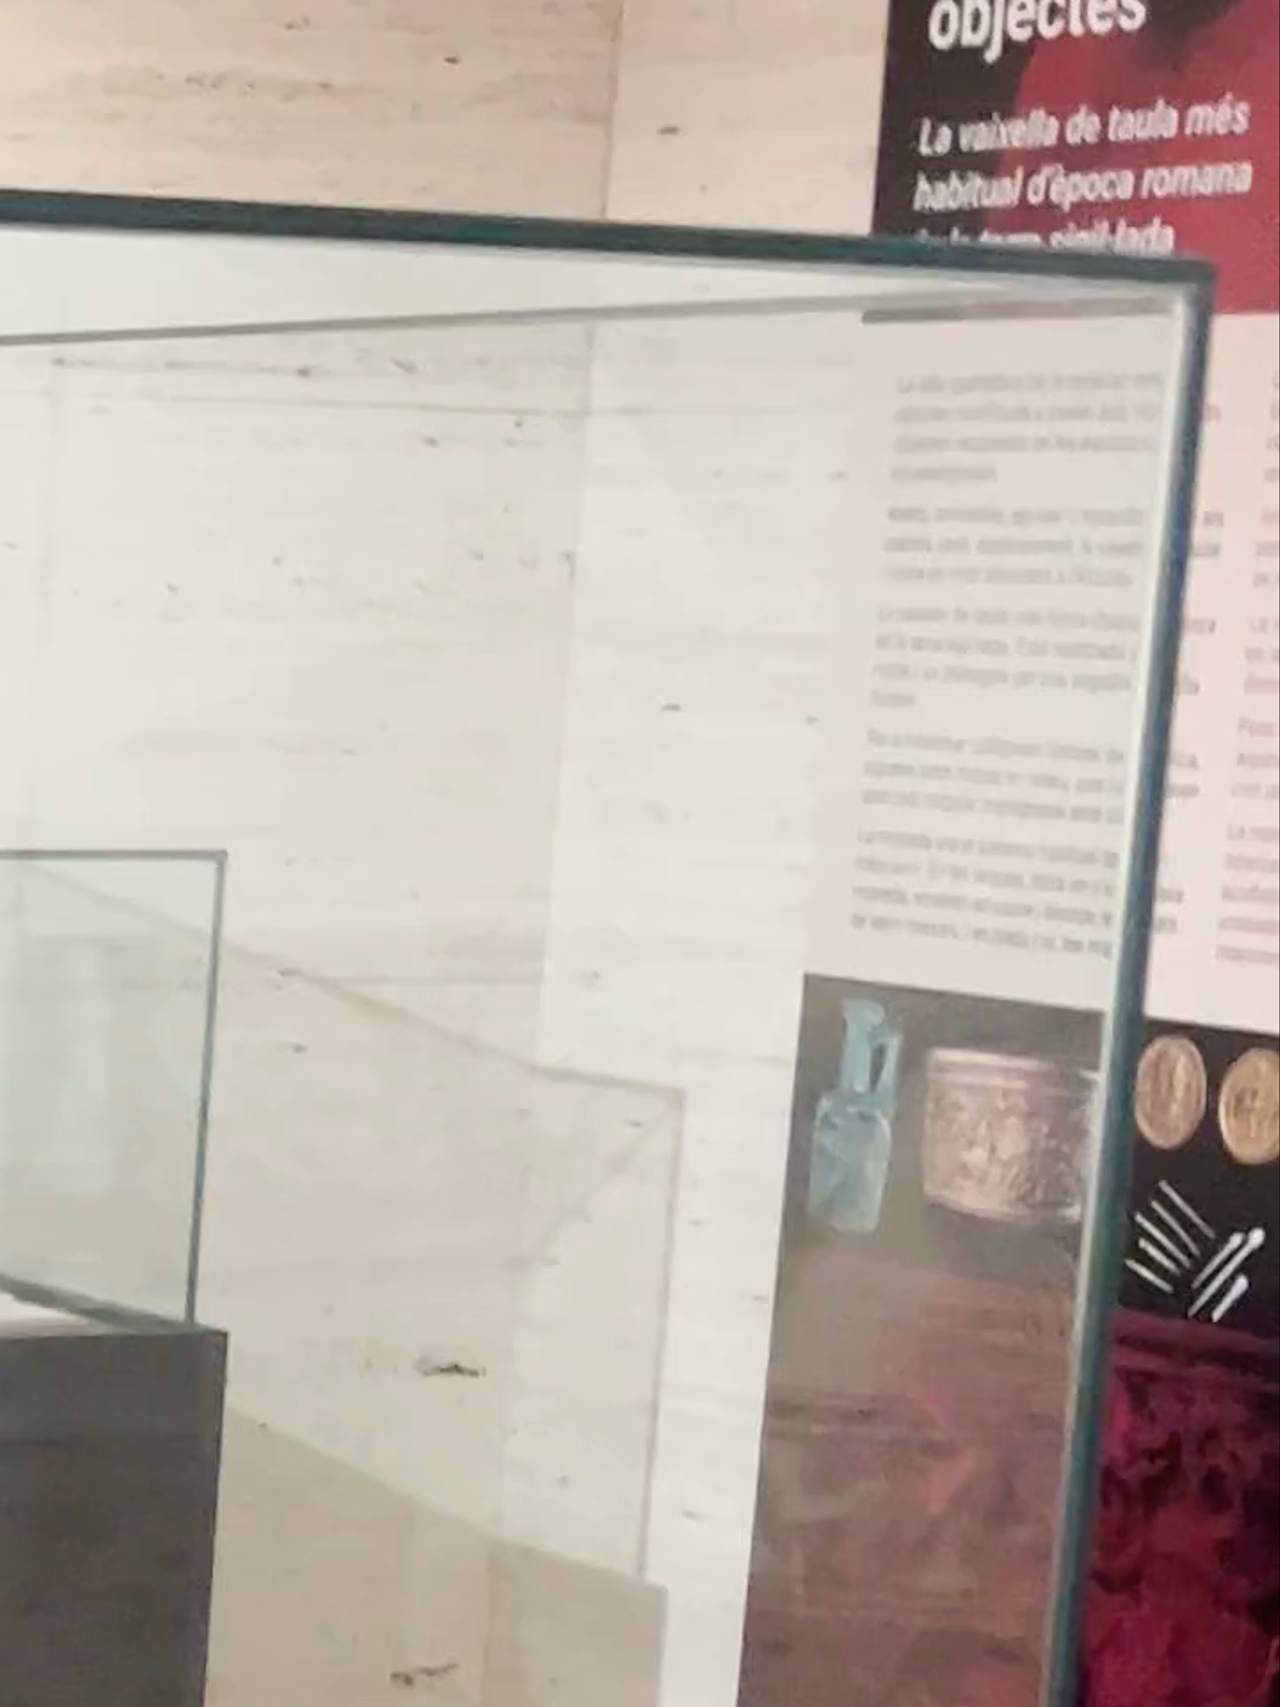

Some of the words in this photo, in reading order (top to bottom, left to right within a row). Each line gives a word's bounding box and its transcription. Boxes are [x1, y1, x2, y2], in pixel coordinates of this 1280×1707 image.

[917, 116, 953, 157] La
[1065, 103, 1102, 147] de
[1107, 97, 1179, 142] taula
[1185, 91, 1252, 136] més
[913, 163, 1024, 212] habitual
[1141, 161, 1254, 199] romana
